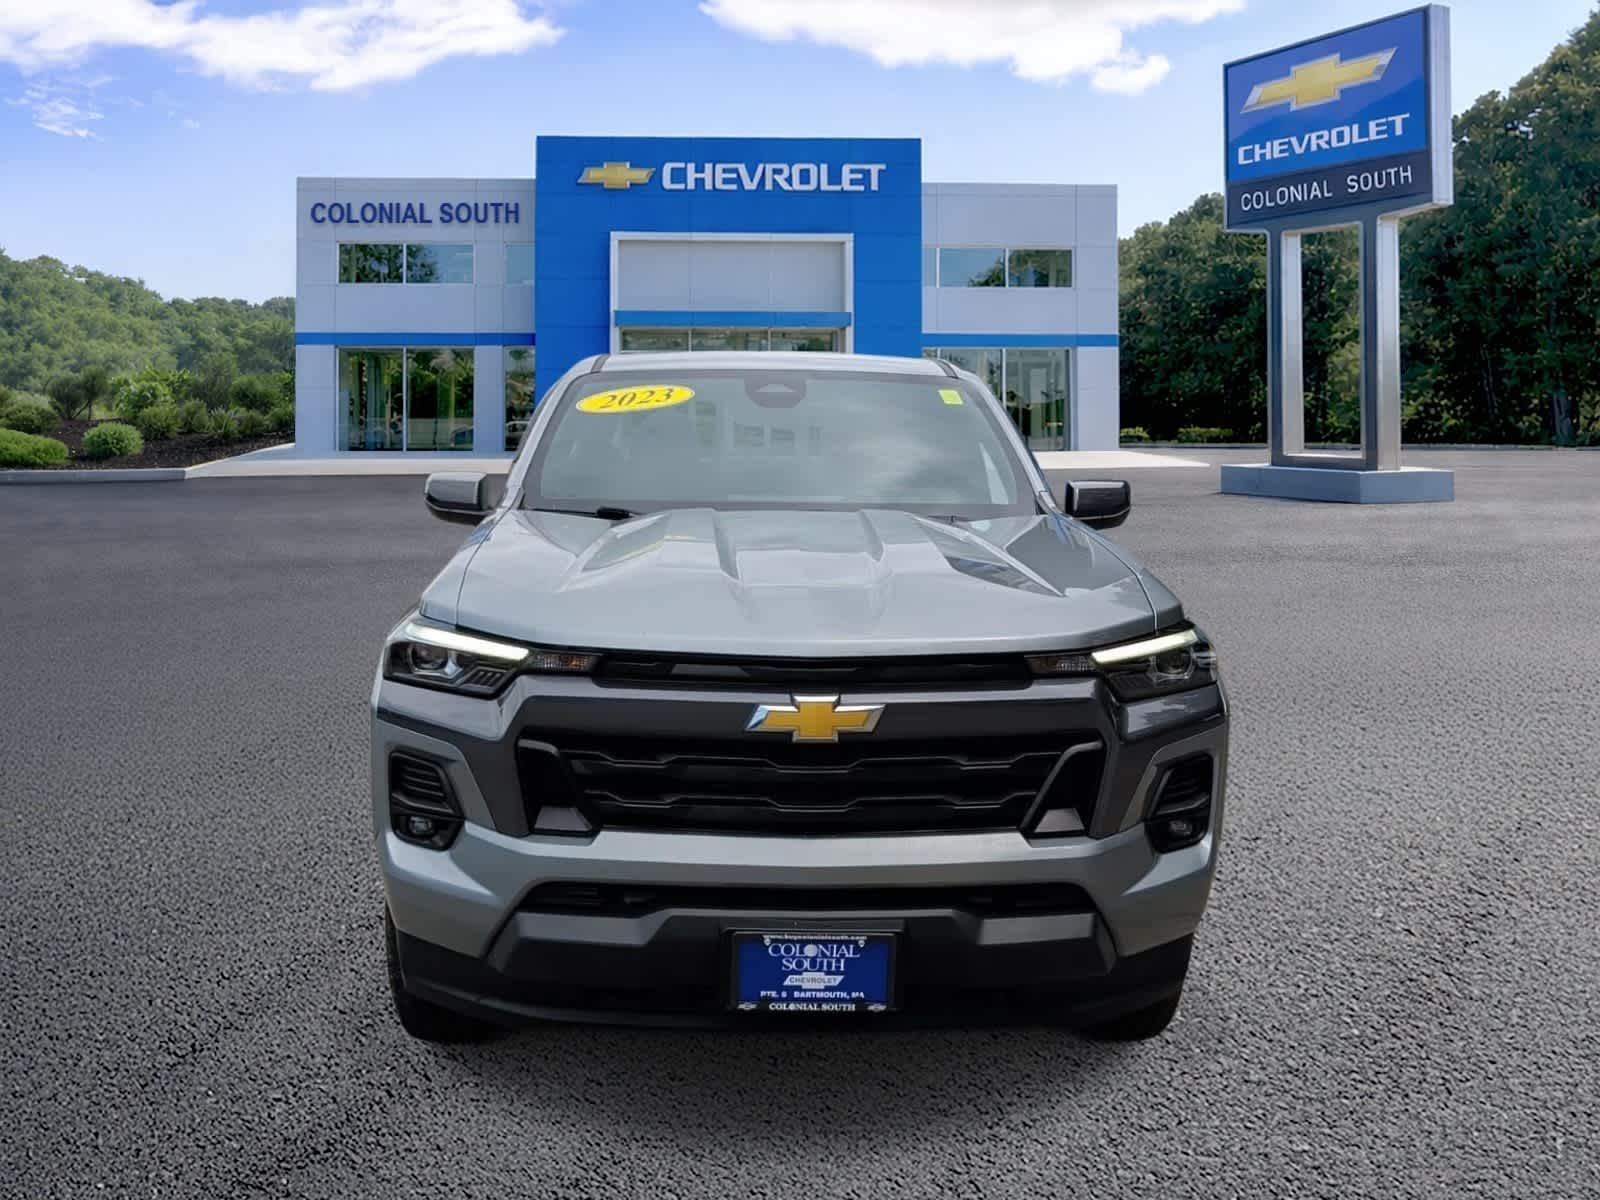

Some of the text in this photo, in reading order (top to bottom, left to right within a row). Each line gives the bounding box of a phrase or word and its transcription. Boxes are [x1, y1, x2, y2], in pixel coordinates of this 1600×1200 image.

[1237, 113, 1410, 165] CHEVROLET
[662, 162, 887, 192] CHEVROLET
[1241, 165, 1412, 211] COLONIAL SOUTH
[310, 202, 520, 224] COLONIAL SOUTH
[600, 388, 675, 409] 2023
[768, 943, 860, 958] COLONIAL
[782, 958, 845, 971] SOUTH
[789, 976, 838, 984] CHEVROLET
[769, 1002, 856, 1011] COLONIAL SOUTH
